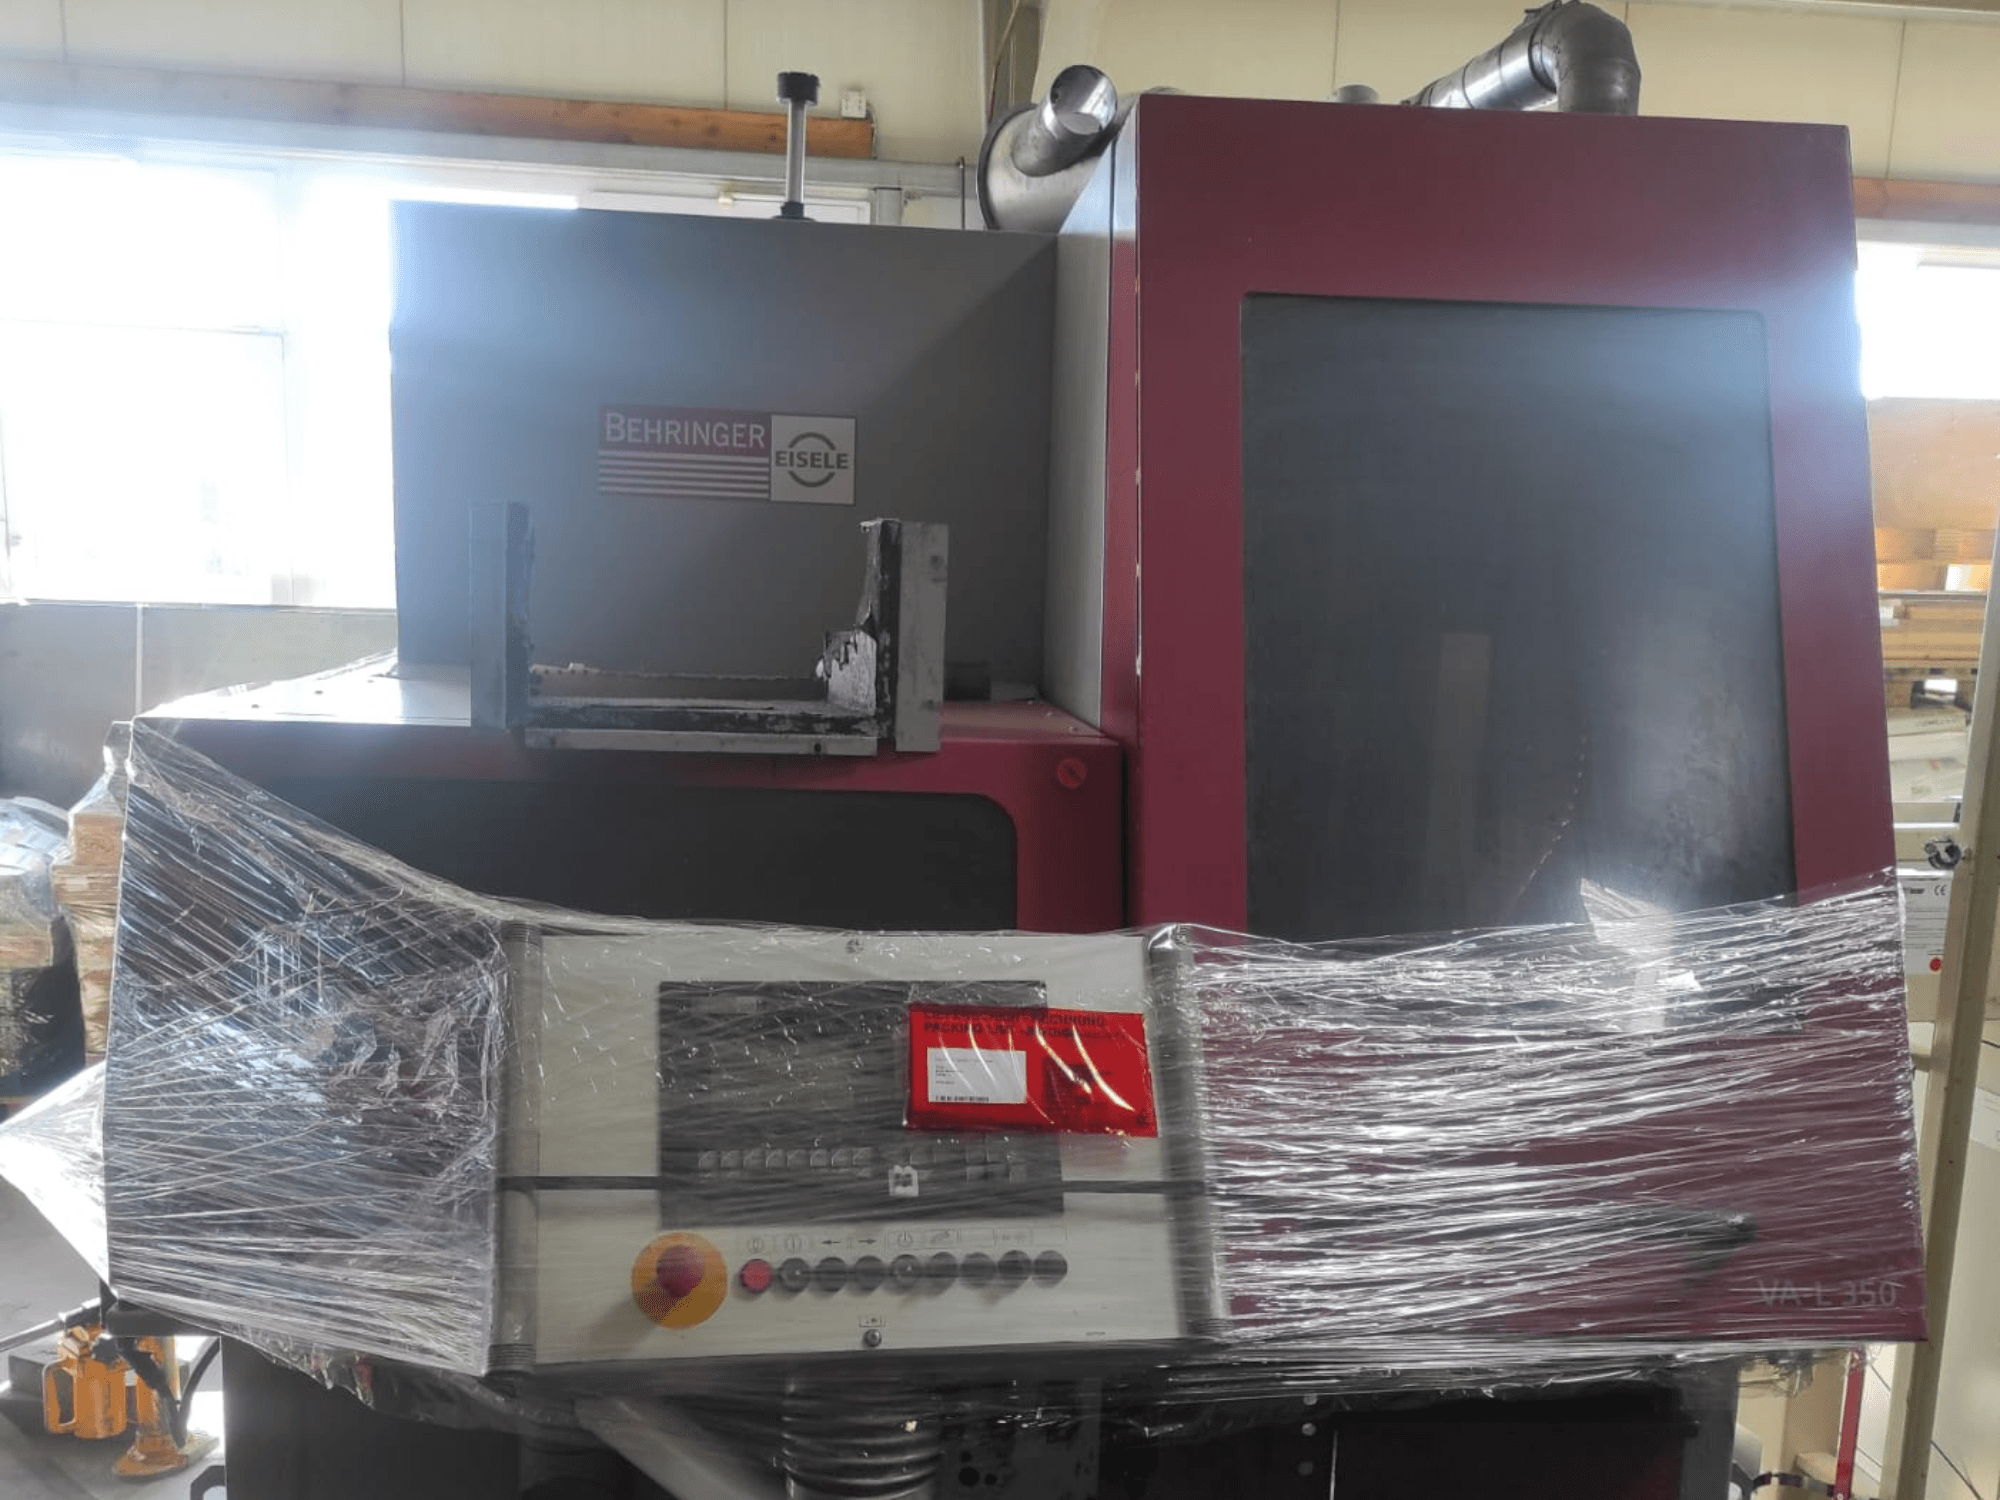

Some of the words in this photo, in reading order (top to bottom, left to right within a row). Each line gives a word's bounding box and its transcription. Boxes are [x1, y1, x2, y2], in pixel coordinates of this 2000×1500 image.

[605, 411, 766, 449] BEHRINGER
[775, 450, 849, 470] EISELE
[1934, 885, 1947, 896] CE
[1840, 1279, 1897, 1308] 350
